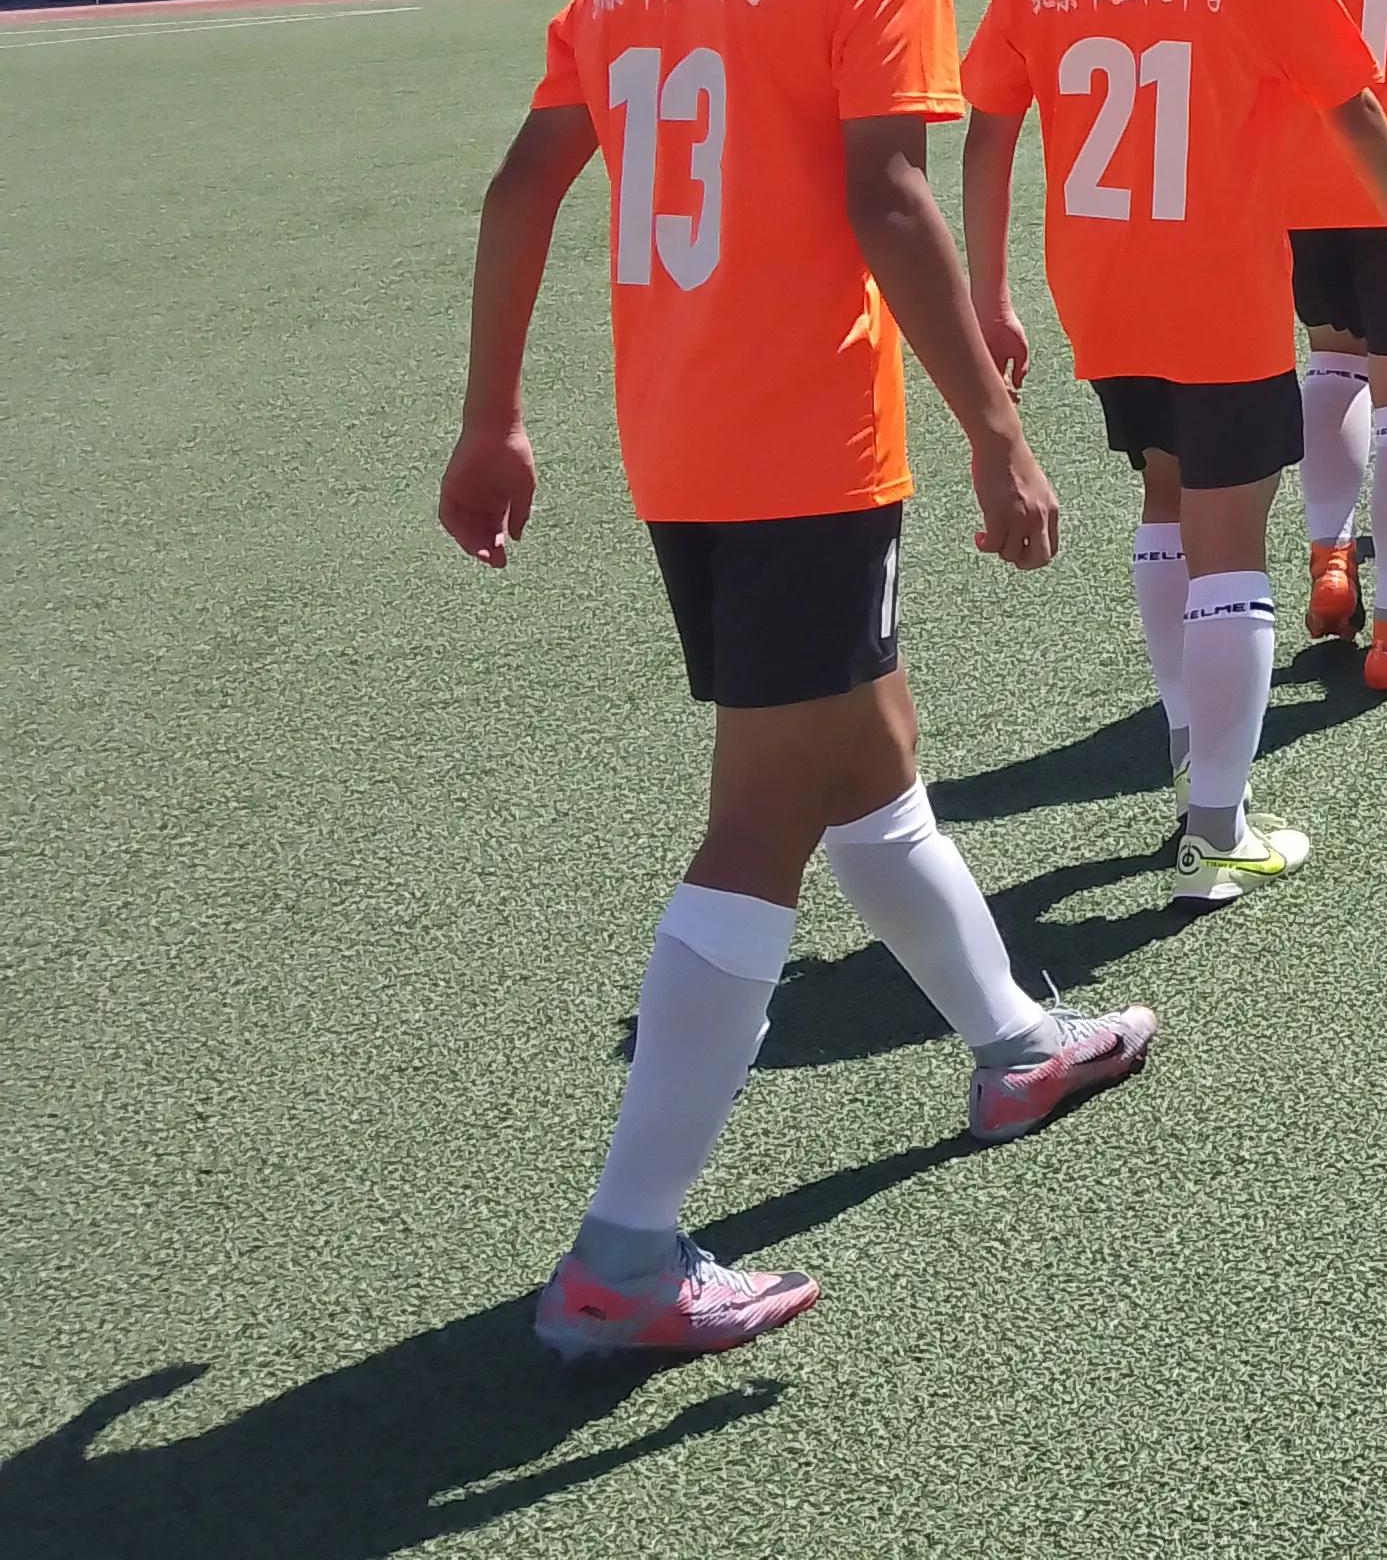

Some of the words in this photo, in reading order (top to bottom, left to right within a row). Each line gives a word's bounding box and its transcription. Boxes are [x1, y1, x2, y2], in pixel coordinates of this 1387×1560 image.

[609, 46, 727, 292] 13
[1058, 36, 1193, 222] 21
[1306, 369, 1353, 380] ELME
